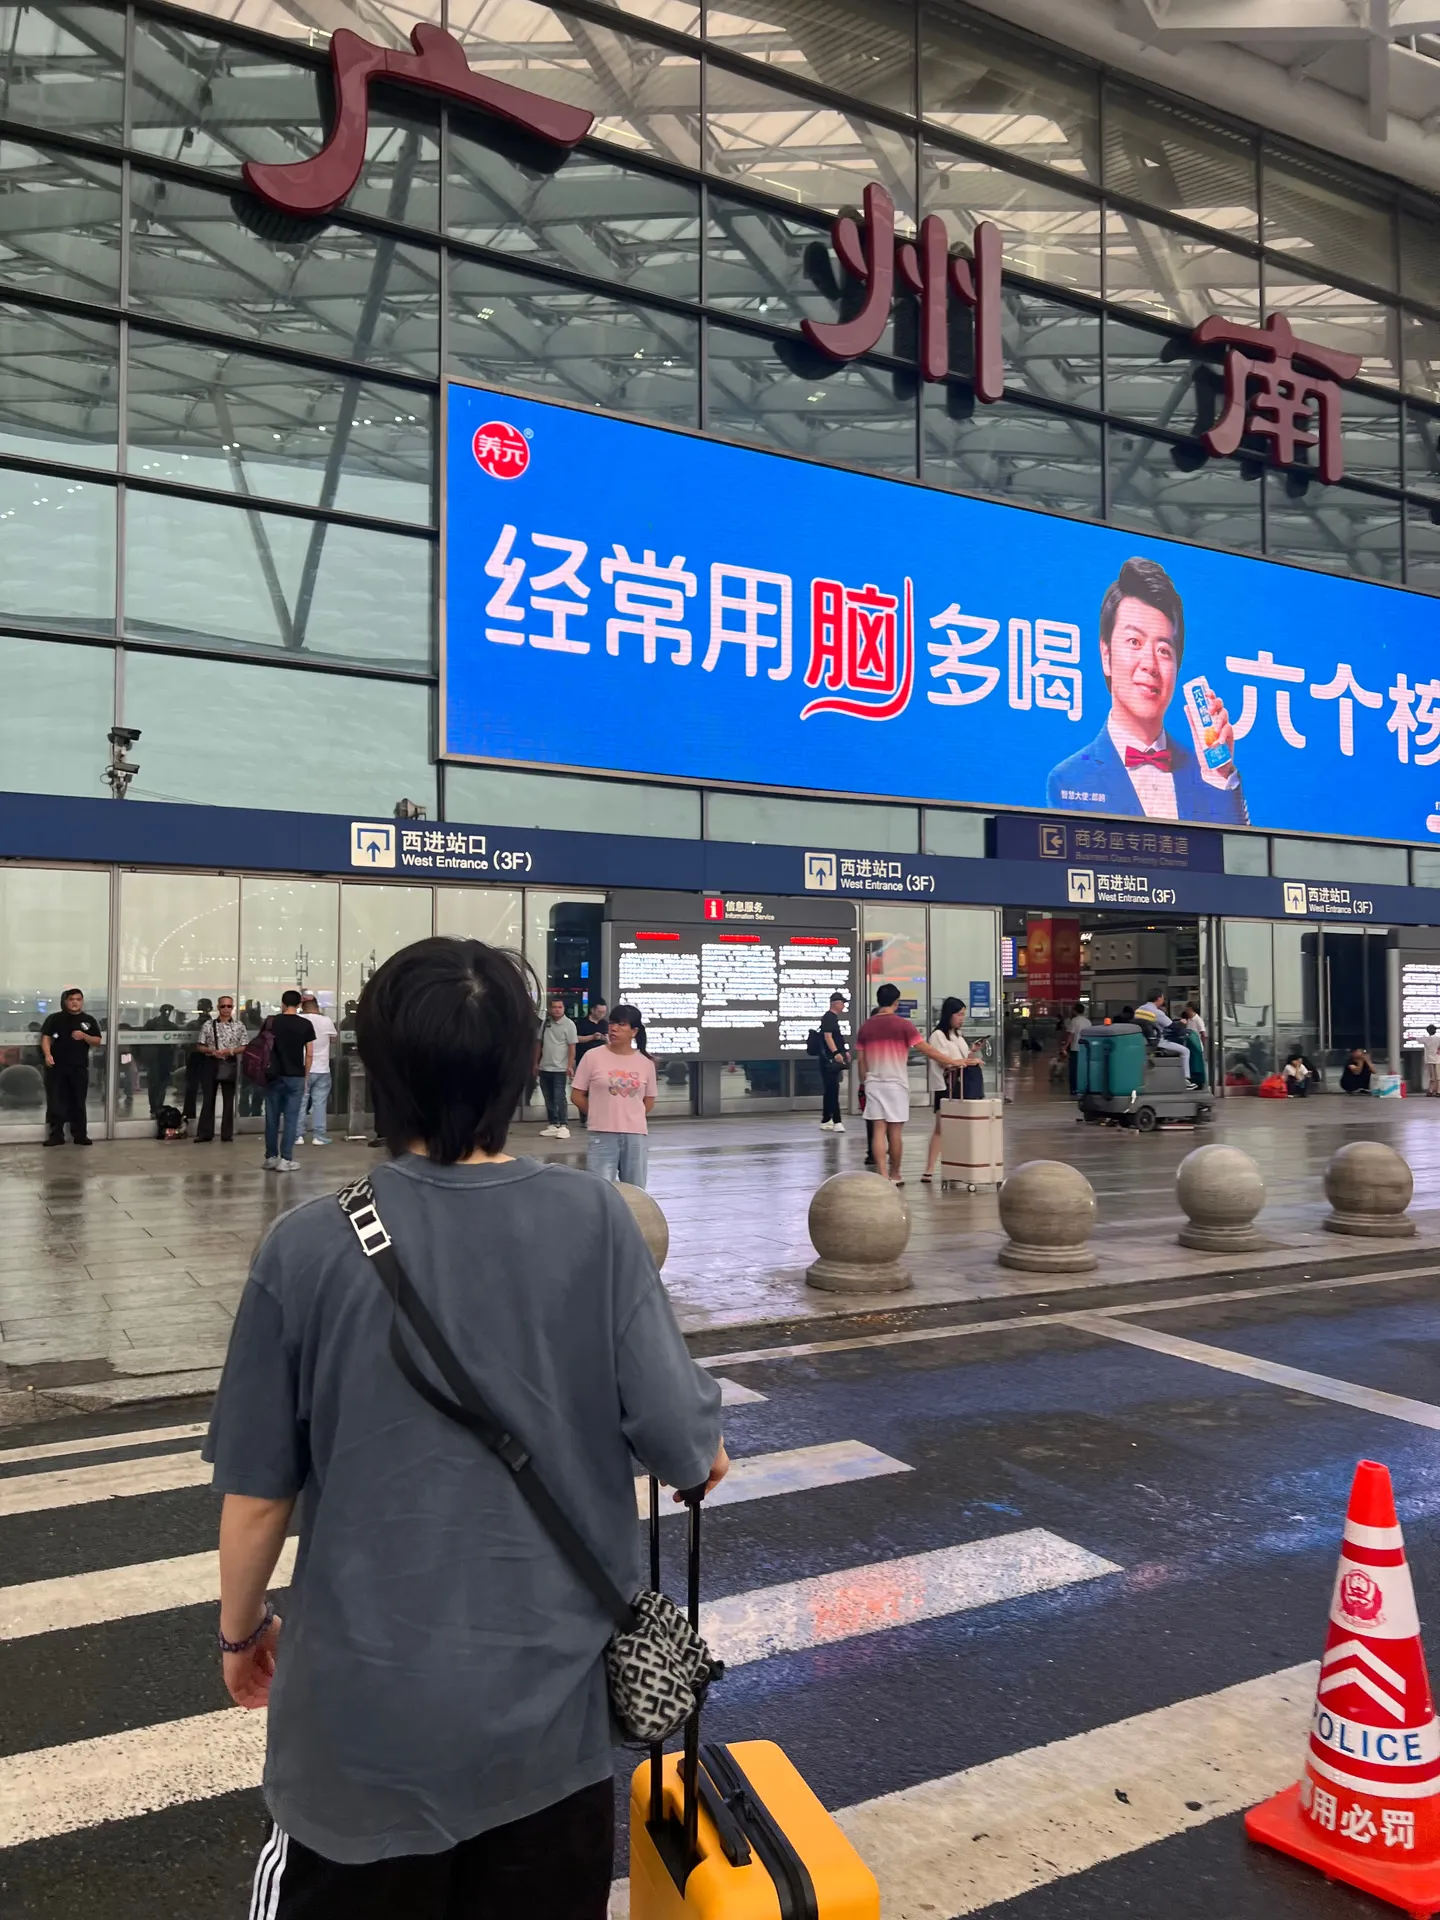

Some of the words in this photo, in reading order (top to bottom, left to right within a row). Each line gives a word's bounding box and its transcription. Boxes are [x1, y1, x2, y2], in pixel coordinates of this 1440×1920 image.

[241, 22, 1362, 484] 广州南
[478, 434, 525, 466] 养元
[401, 830, 487, 855] 西进站口
[1074, 829, 1189, 855] 商务座专用通道
[401, 853, 433, 867] West
[436, 855, 488, 870] Entrance
[493, 850, 532, 872] (3F)
[840, 858, 902, 879] 西进站口
[841, 878, 863, 889] West
[865, 879, 903, 891] Entrance
[906, 874, 935, 892] (3F)
[1096, 874, 1149, 892] 西进站口
[1098, 891, 1117, 903] West
[1118, 892, 1150, 904] Entrance
[1152, 888, 1177, 905] (3F)
[1307, 887, 1351, 904] 西进站口
[725, 900, 764, 913] 信息服务
[1308, 903, 1325, 913] West
[1326, 904, 1352, 914] Entrance
[1353, 900, 1373, 915] (3F)
[755, 913, 775, 921] Service
[1300, 1776, 1415, 1850] 用必罚
